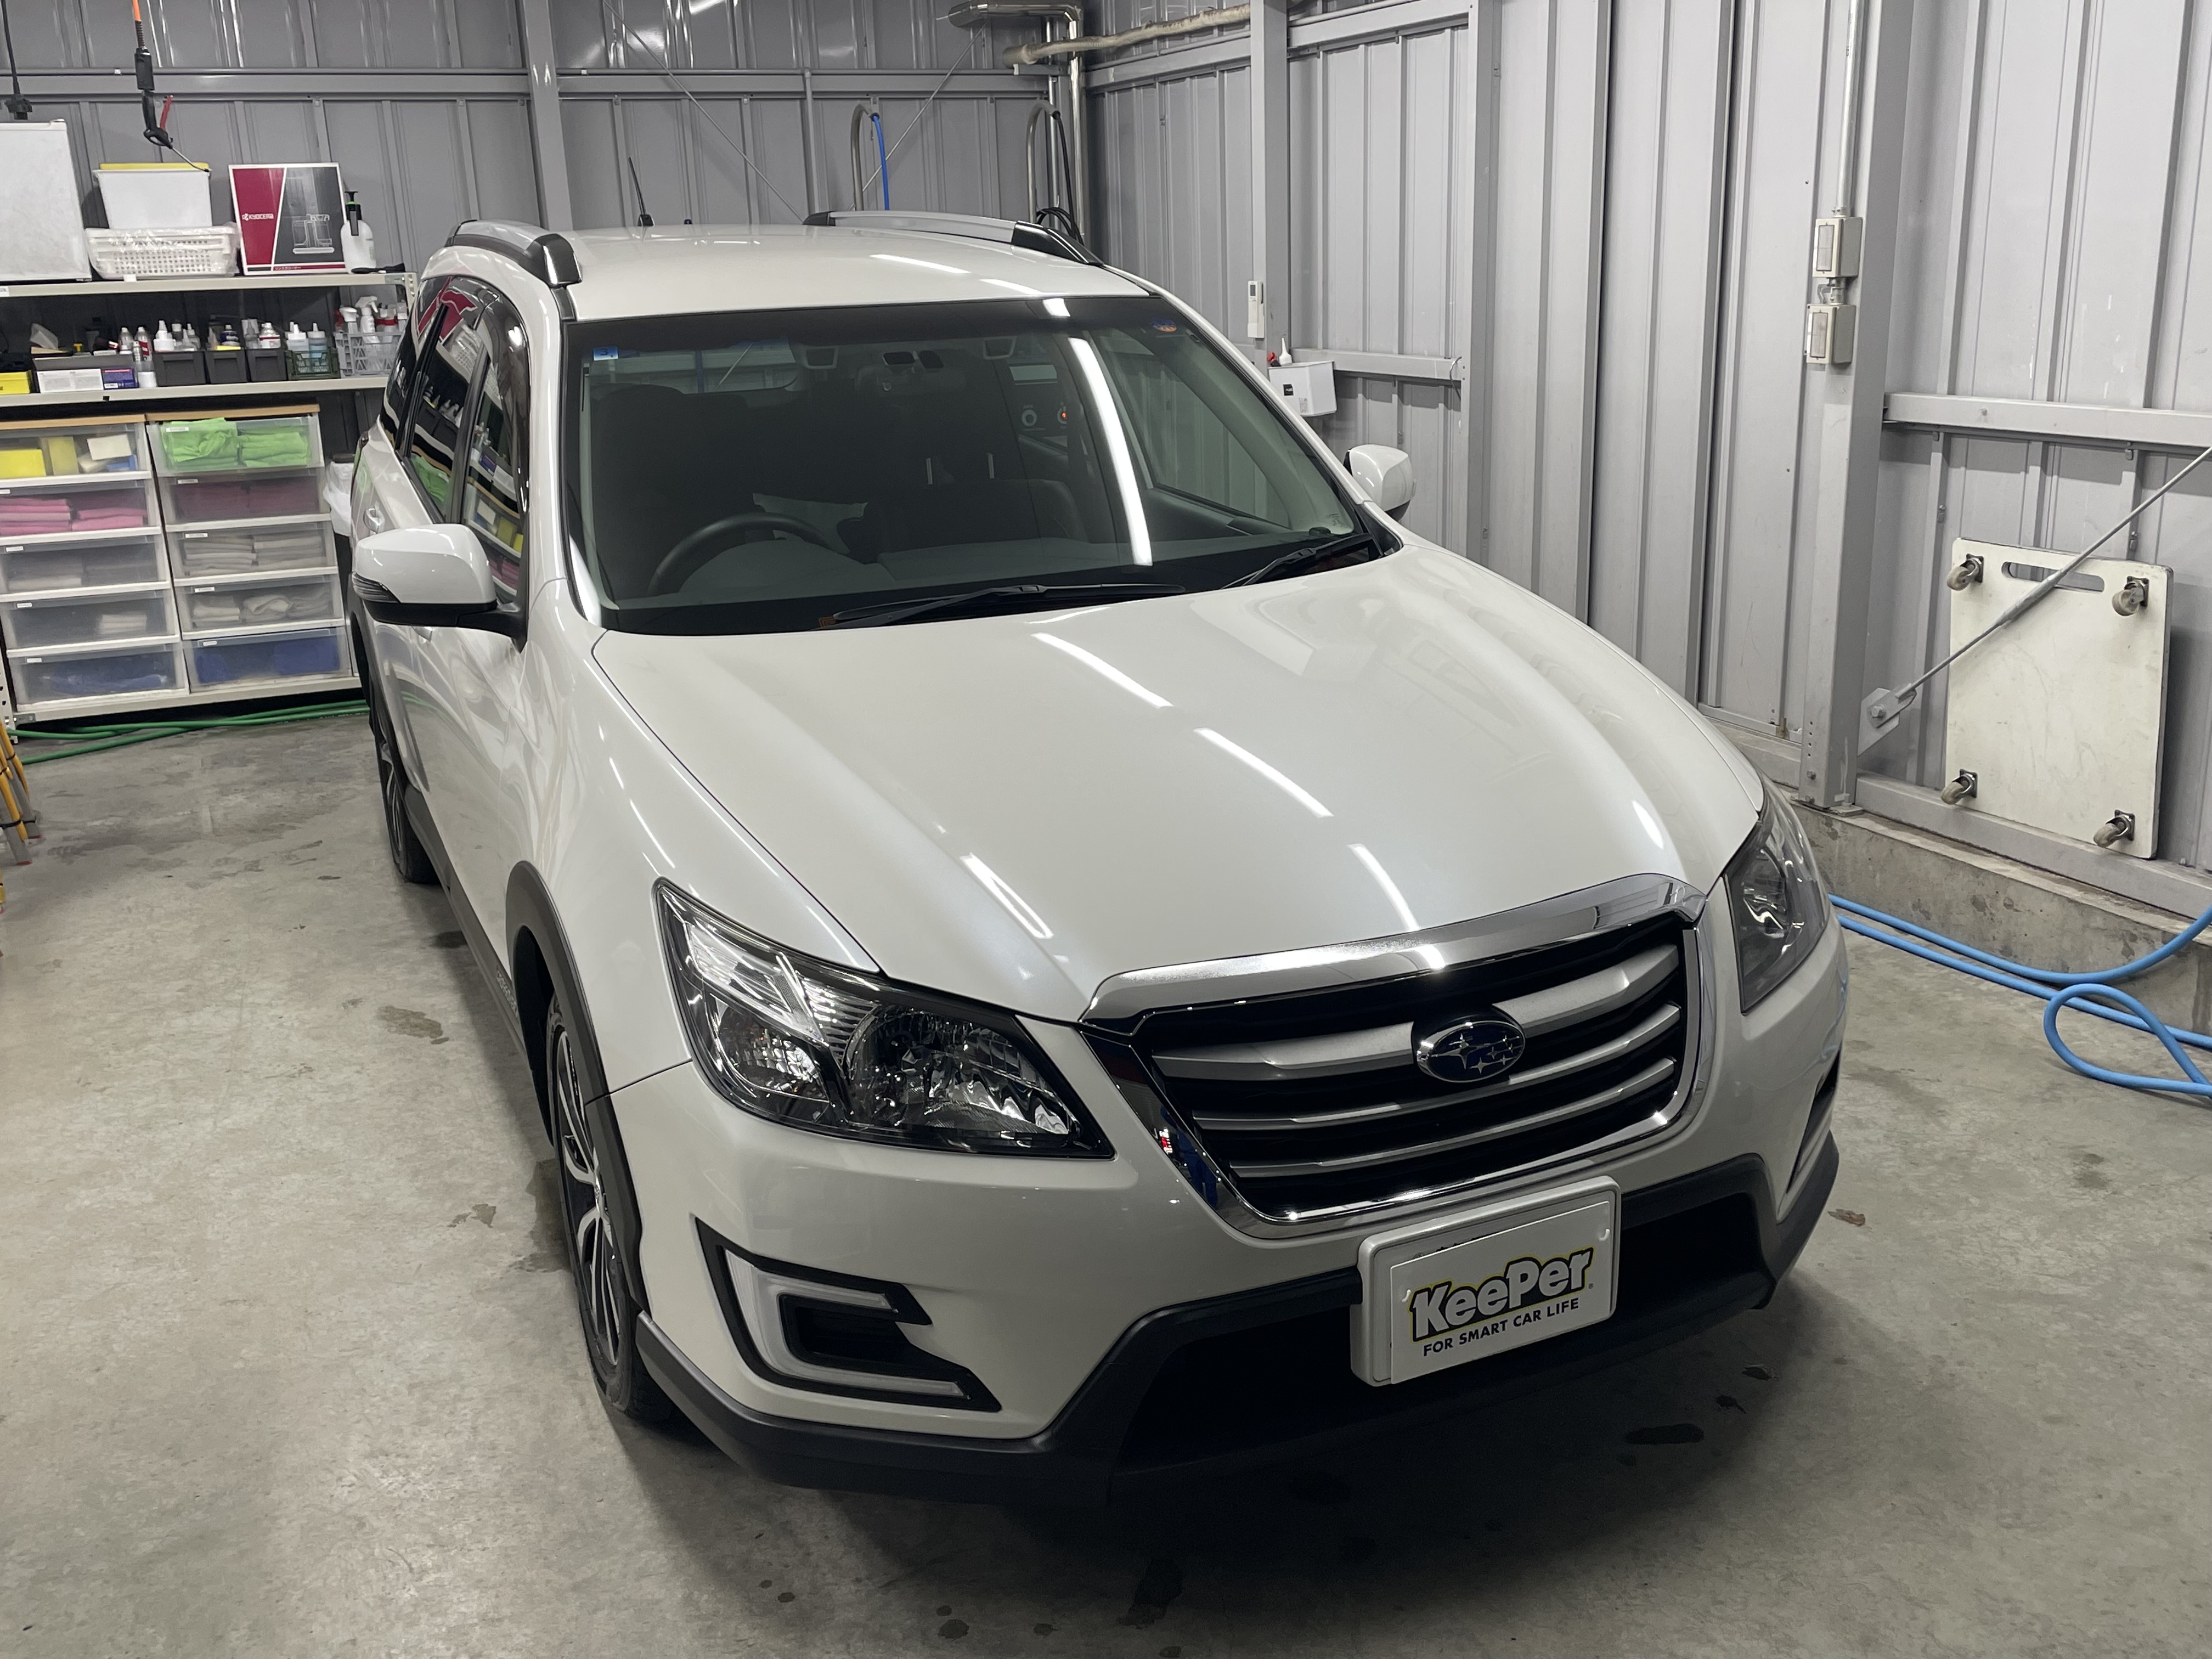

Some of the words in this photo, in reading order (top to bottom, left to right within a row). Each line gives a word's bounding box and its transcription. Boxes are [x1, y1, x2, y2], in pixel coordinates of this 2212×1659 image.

[1409, 1247, 1594, 1342] KeePer
[1423, 1338, 1453, 1357] FOR
[1459, 1319, 1508, 1345] SMART
[1513, 1310, 1542, 1327] CAR
[1547, 1297, 1579, 1317] LIFE
